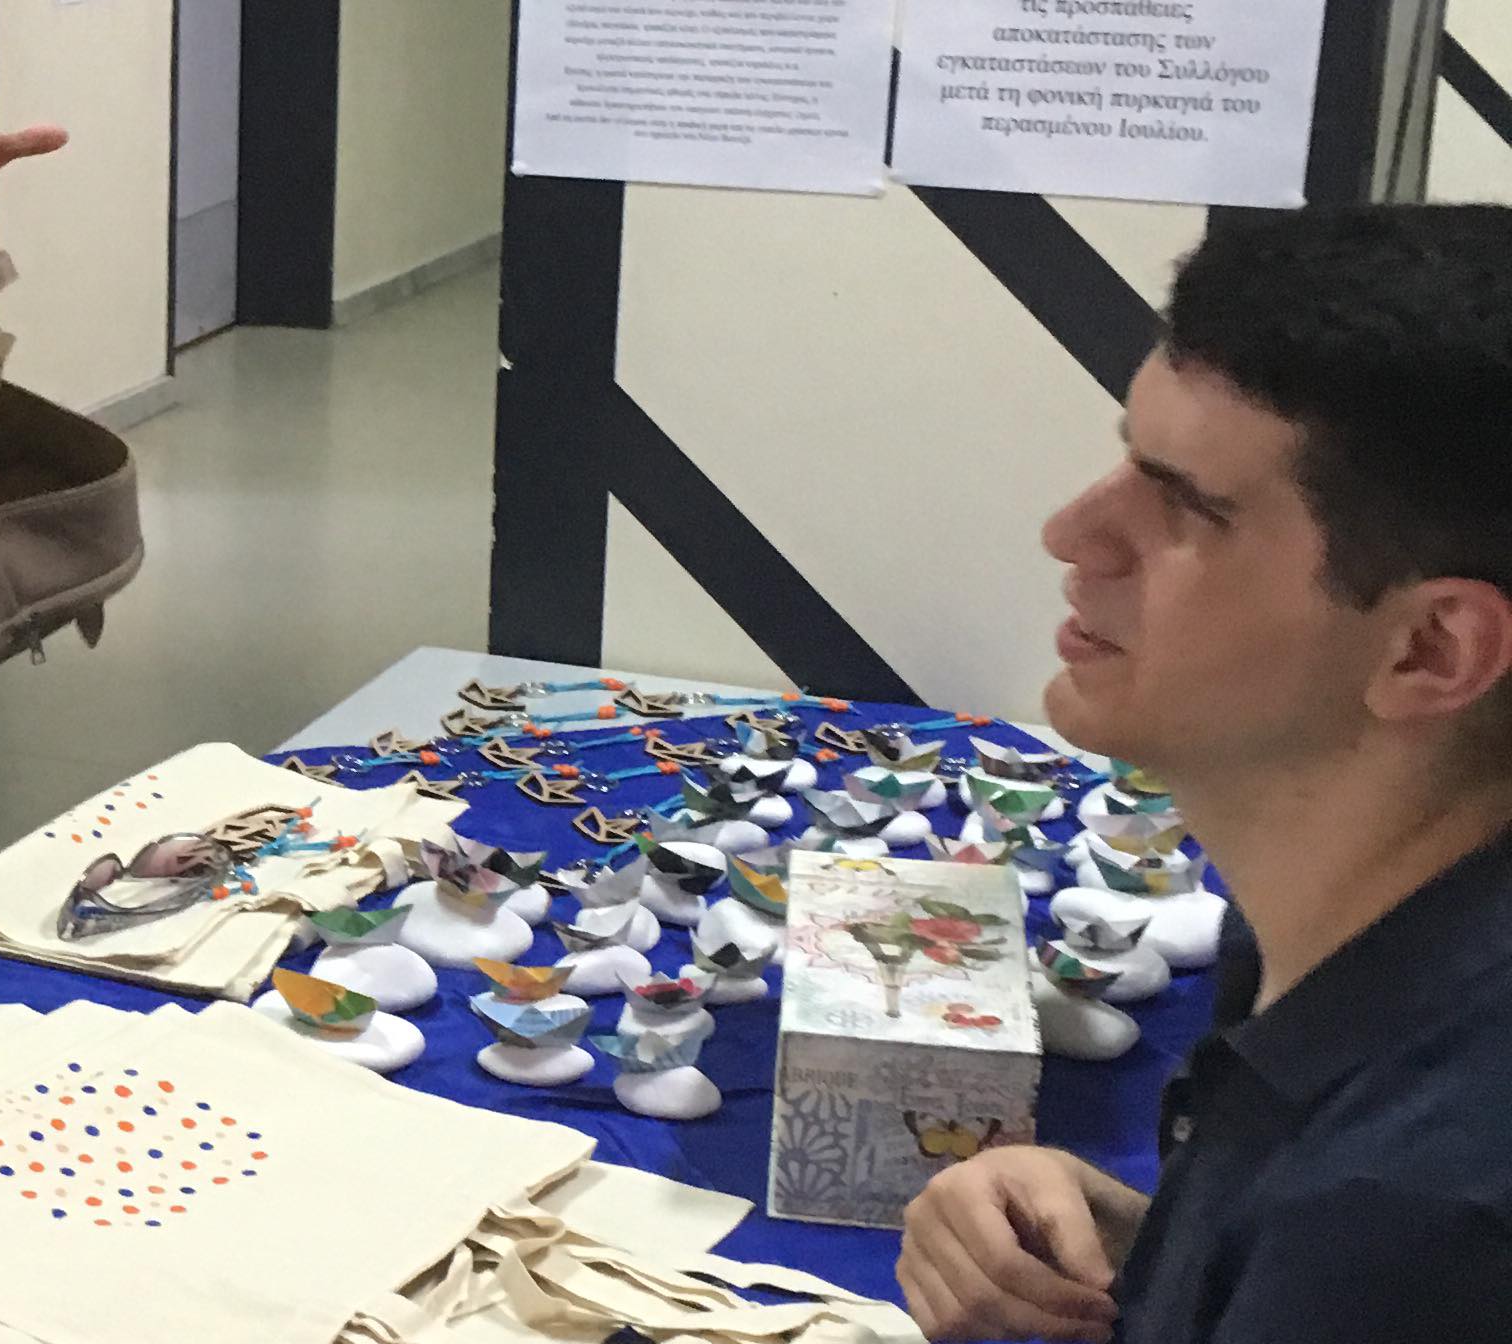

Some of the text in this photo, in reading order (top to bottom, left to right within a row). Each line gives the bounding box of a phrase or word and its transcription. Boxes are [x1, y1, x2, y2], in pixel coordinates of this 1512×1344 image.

[992, 25, 1216, 53] αποκατάστασης των
[936, 53, 1270, 86] εγκαταστάσεων του Συλλόγου
[940, 81, 1261, 115] μετά τη φονική πυρκαγιά του
[981, 115, 1208, 142] περασμένου Ιουλίου.
